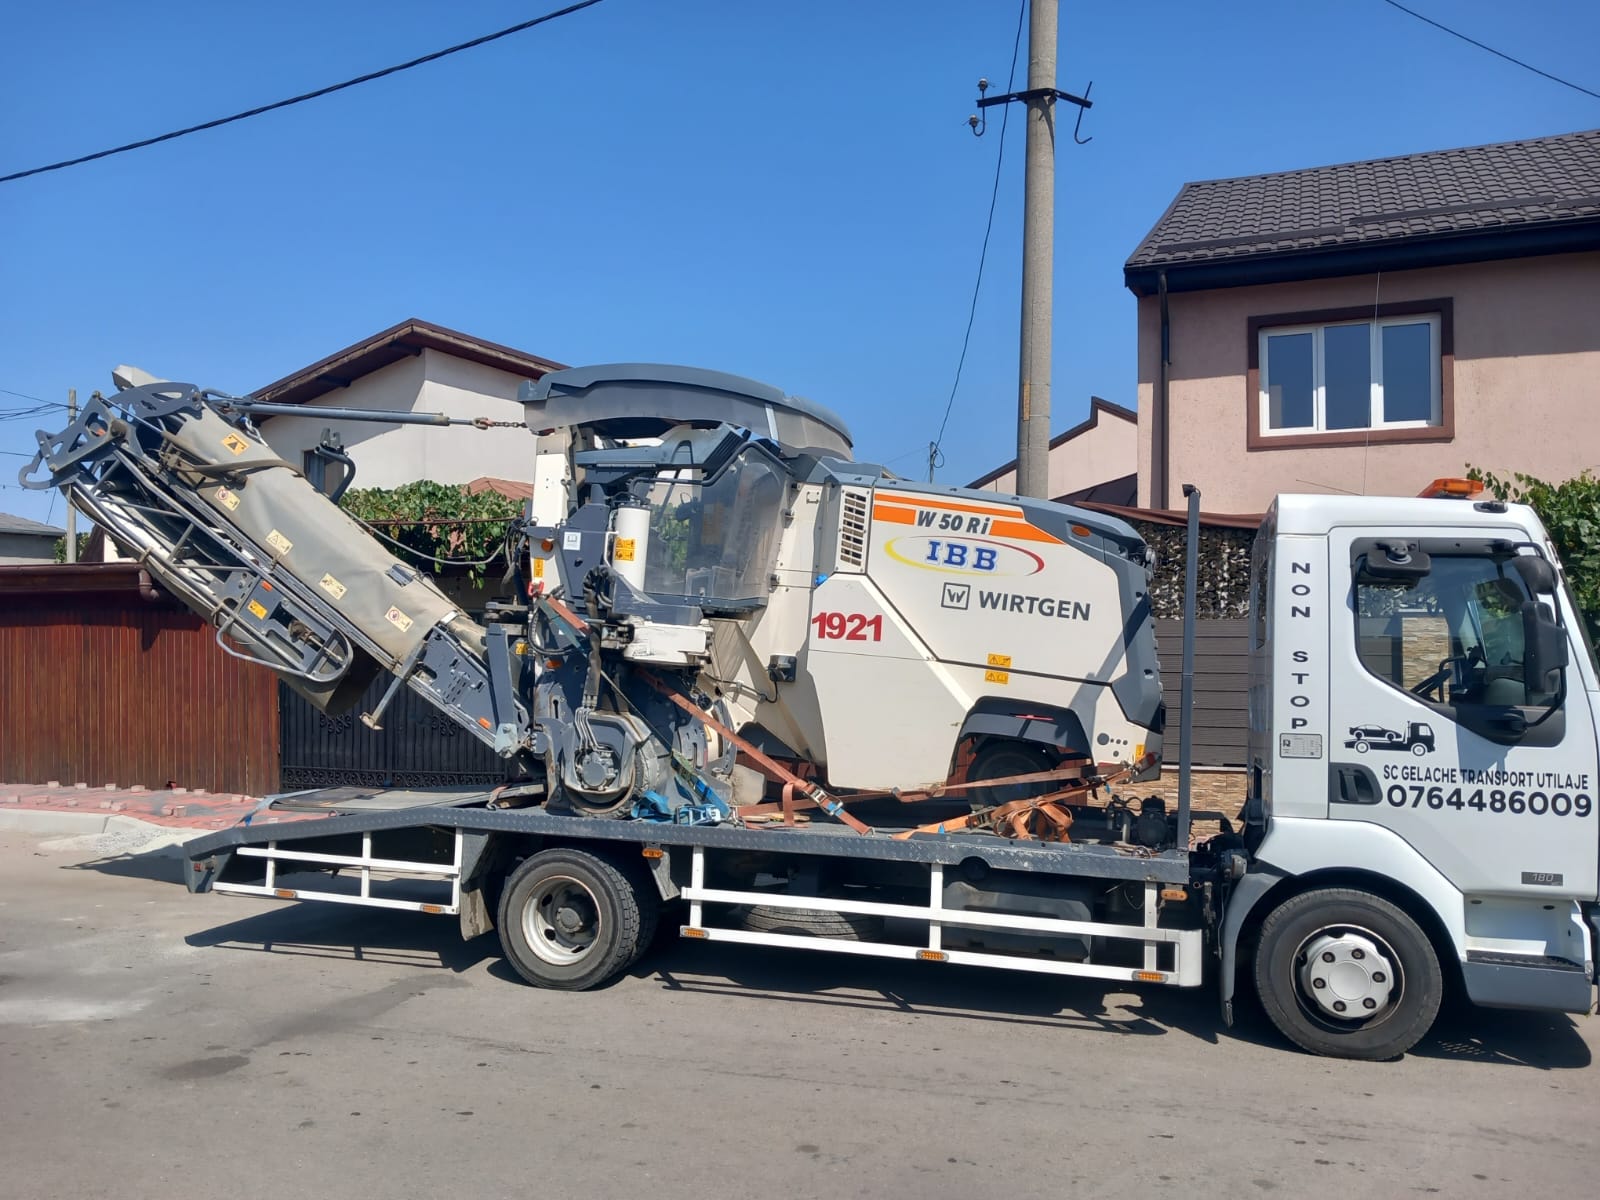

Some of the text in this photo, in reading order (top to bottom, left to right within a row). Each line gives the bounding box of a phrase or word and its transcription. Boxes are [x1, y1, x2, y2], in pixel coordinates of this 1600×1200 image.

[917, 510, 990, 534] W 50 Ri
[926, 540, 998, 571] IBB
[979, 590, 1091, 621] WIRTGEN
[1291, 562, 1311, 618] NON
[811, 612, 883, 641] 1921
[1290, 650, 1310, 729] STOP
[1383, 764, 1588, 790] SC GELACHE TRANSPORT UTILAJE
[1387, 784, 1592, 818] 0764486009
[1531, 873, 1554, 882] 180
